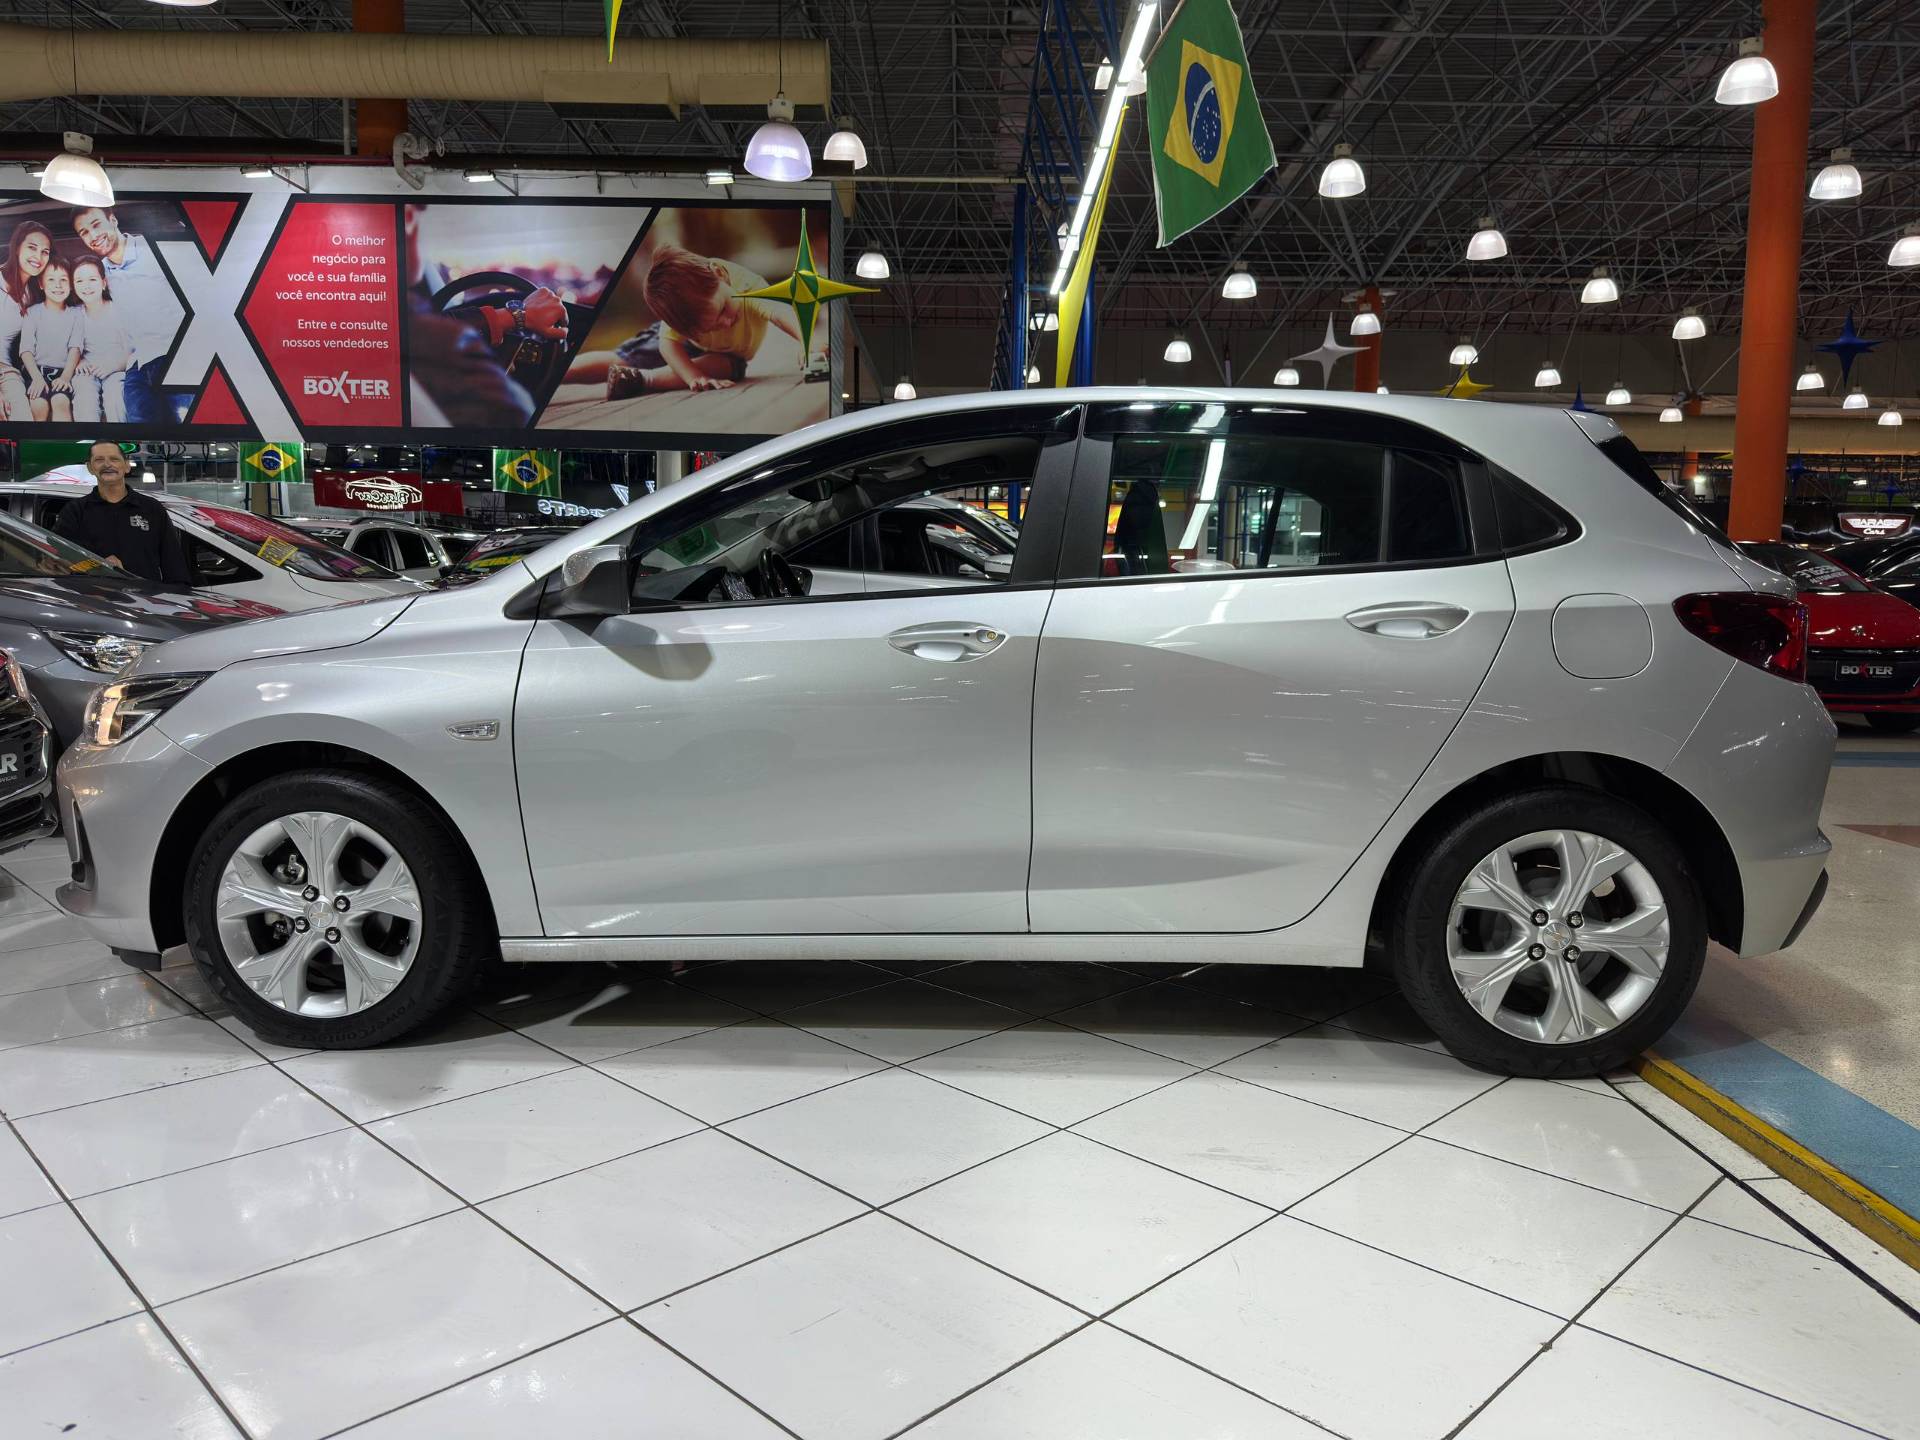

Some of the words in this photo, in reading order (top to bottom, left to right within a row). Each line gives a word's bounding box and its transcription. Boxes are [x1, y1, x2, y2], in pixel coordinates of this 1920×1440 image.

[331, 234, 342, 246] O
[344, 235, 386, 246] melhor
[312, 253, 359, 266] negócio
[361, 255, 386, 267] para
[287, 271, 315, 282] você
[317, 273, 325, 282] e
[327, 273, 347, 282] sua
[349, 272, 387, 283] família
[275, 289, 303, 300] você
[305, 291, 357, 301] encontra
[359, 291, 387, 304] aqui!
[297, 319, 328, 330] Entre
[330, 321, 337, 330] e
[339, 319, 389, 331] consulte
[282, 338, 321, 348] nossos
[323, 338, 390, 349] vendedores
[303, 370, 391, 404] BOXTER
[1841, 663, 1893, 677] BOXTER
